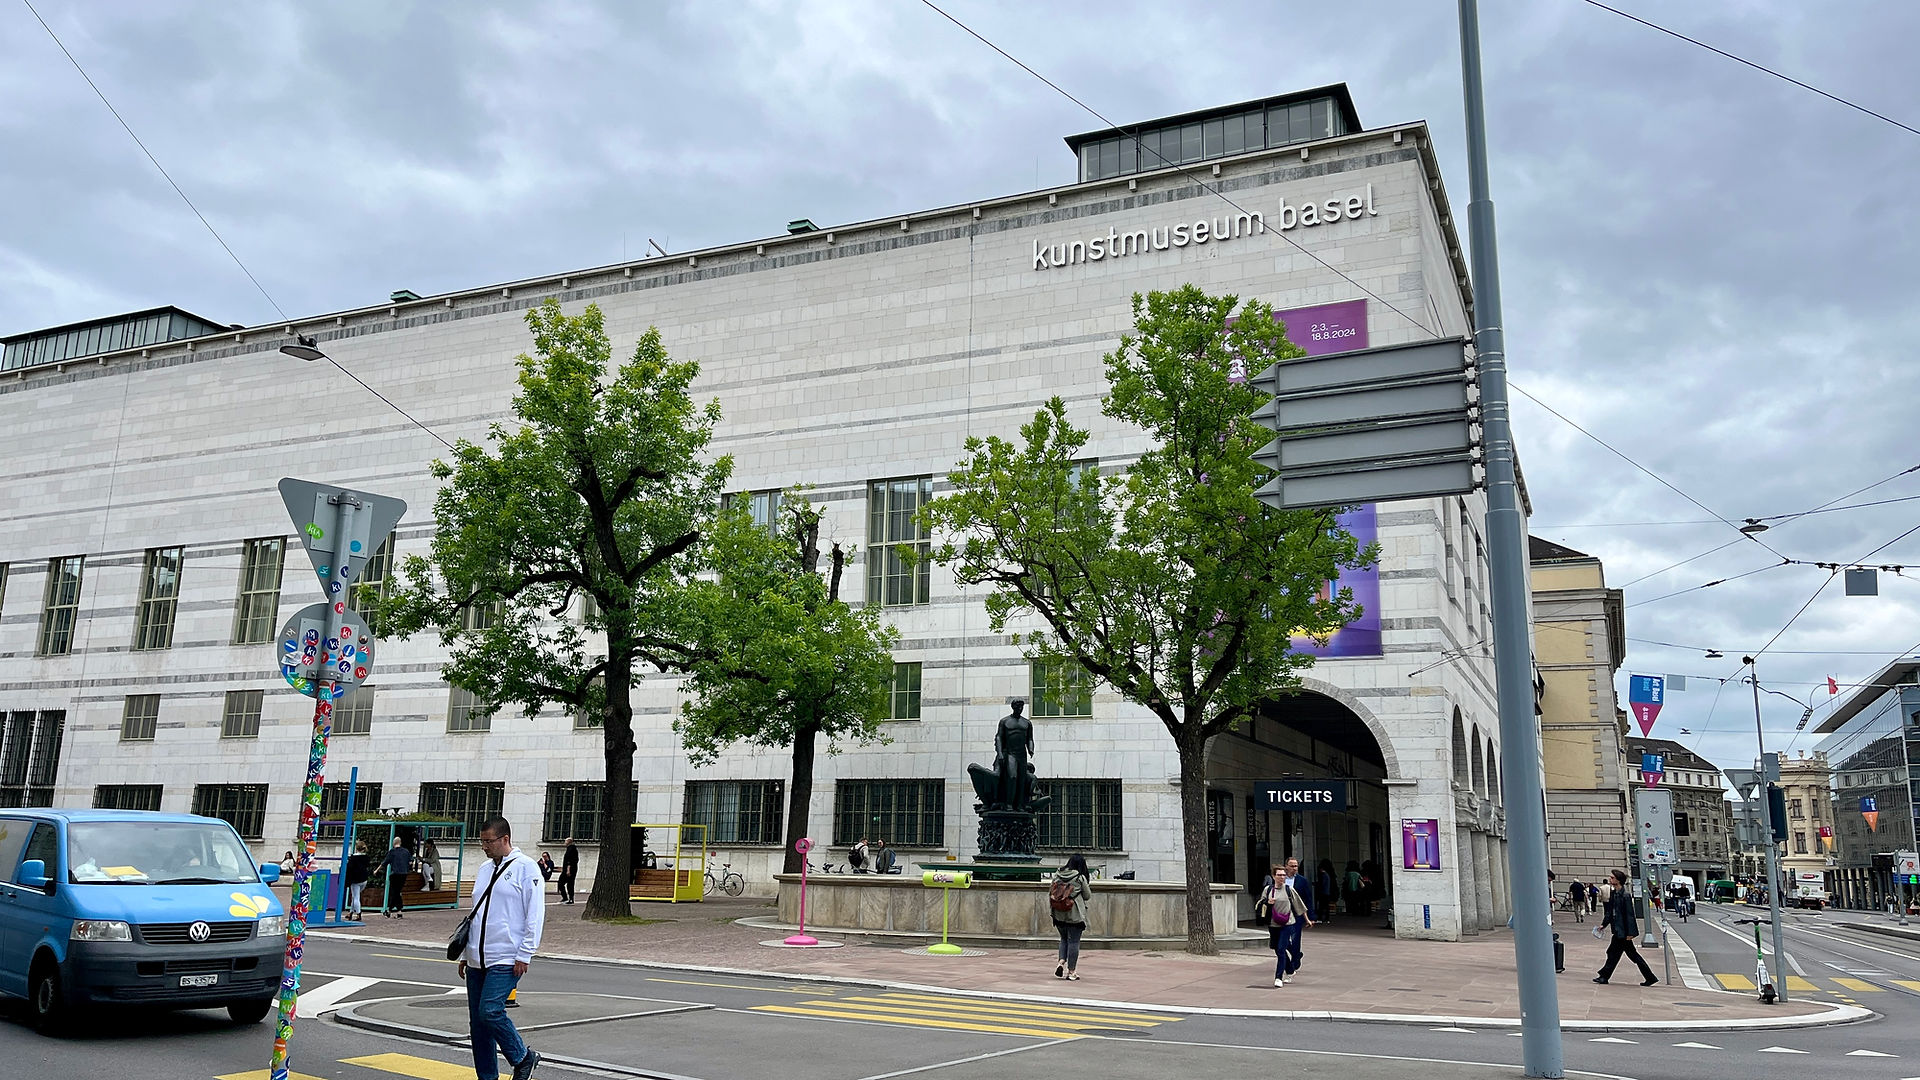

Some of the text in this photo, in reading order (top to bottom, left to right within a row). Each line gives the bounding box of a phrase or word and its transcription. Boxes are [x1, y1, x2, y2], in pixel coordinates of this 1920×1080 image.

[1032, 182, 1378, 270] kunstmuseum basel
[1311, 323, 1329, 333] 2.3.
[1311, 328, 1356, 341] 18.8.2024
[1266, 789, 1334, 804] TICKETS
